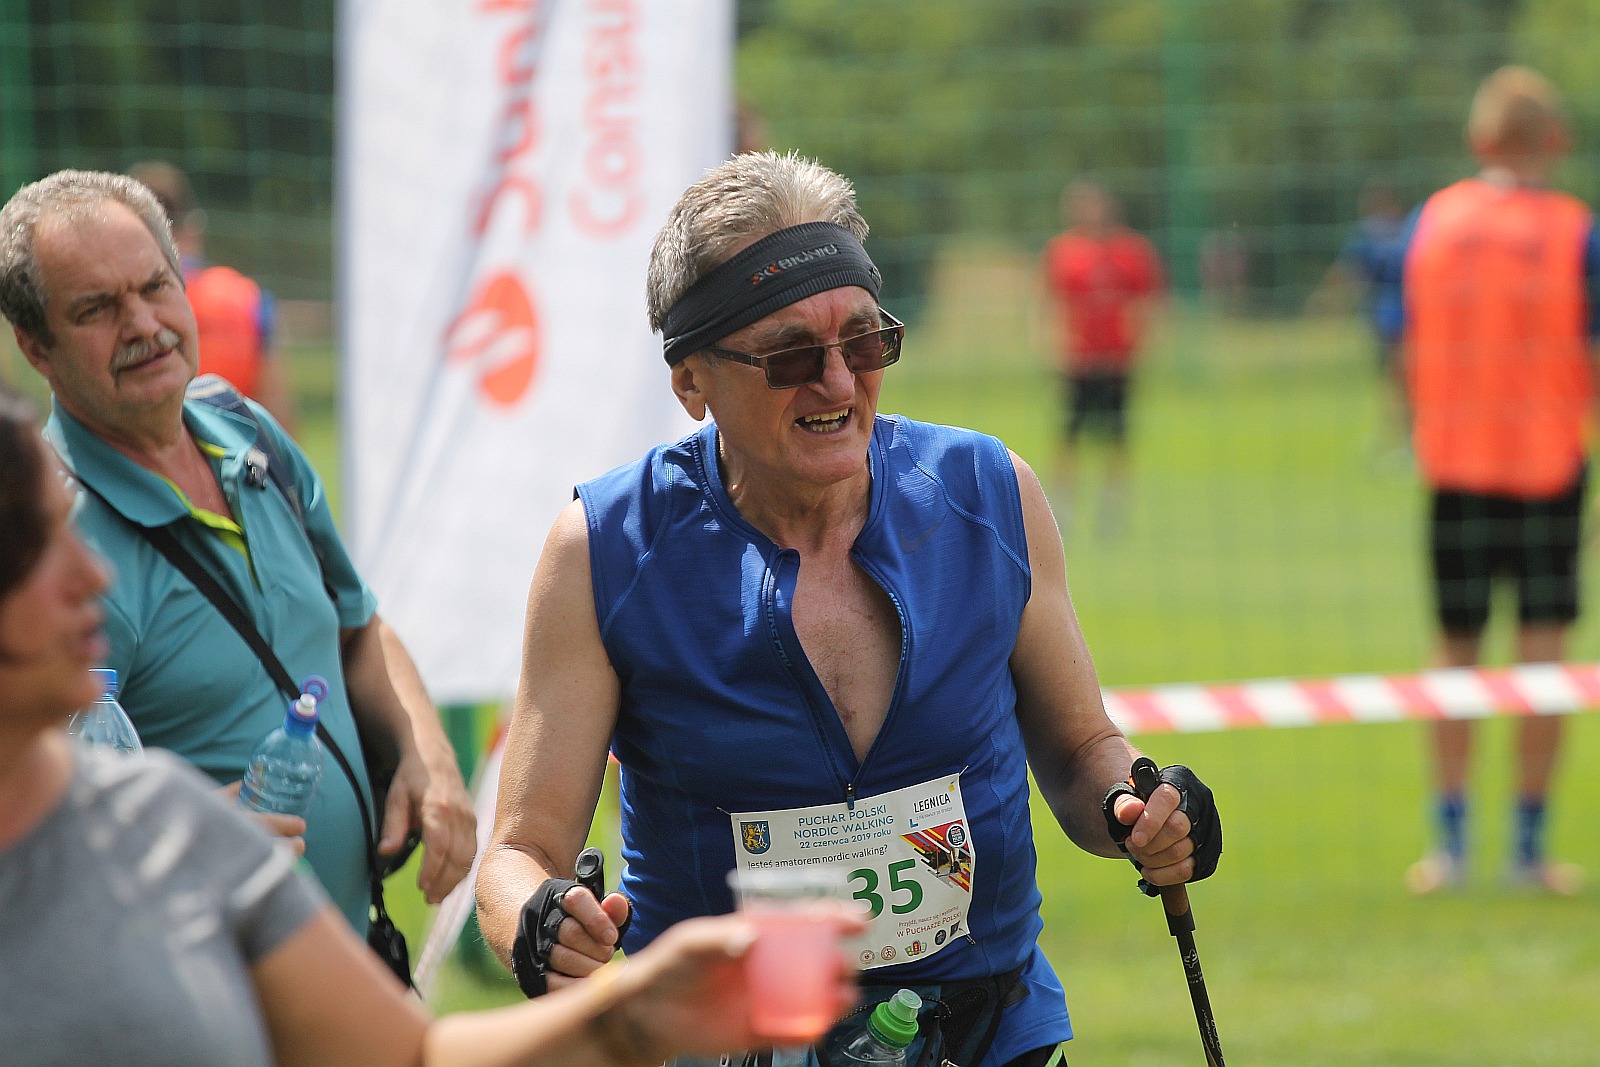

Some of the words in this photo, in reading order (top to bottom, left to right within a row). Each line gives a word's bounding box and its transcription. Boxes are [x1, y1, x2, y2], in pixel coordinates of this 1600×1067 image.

[470, 0, 546, 240] San
[913, 793, 951, 813] LEGNICA
[798, 813, 846, 827] PUCHAR
[849, 804, 887, 821] POLSKI
[793, 826, 840, 840] NORDIC
[841, 815, 894, 834] WALKING
[813, 837, 848, 847] czerwca
[851, 831, 872, 843] 2019
[874, 829, 892, 839] roku
[748, 860, 772, 870] Jesteś
[775, 856, 821, 869] amatorem
[822, 852, 850, 864] nordic
[851, 843, 888, 860] walking?
[941, 910, 962, 925] POLSKI
